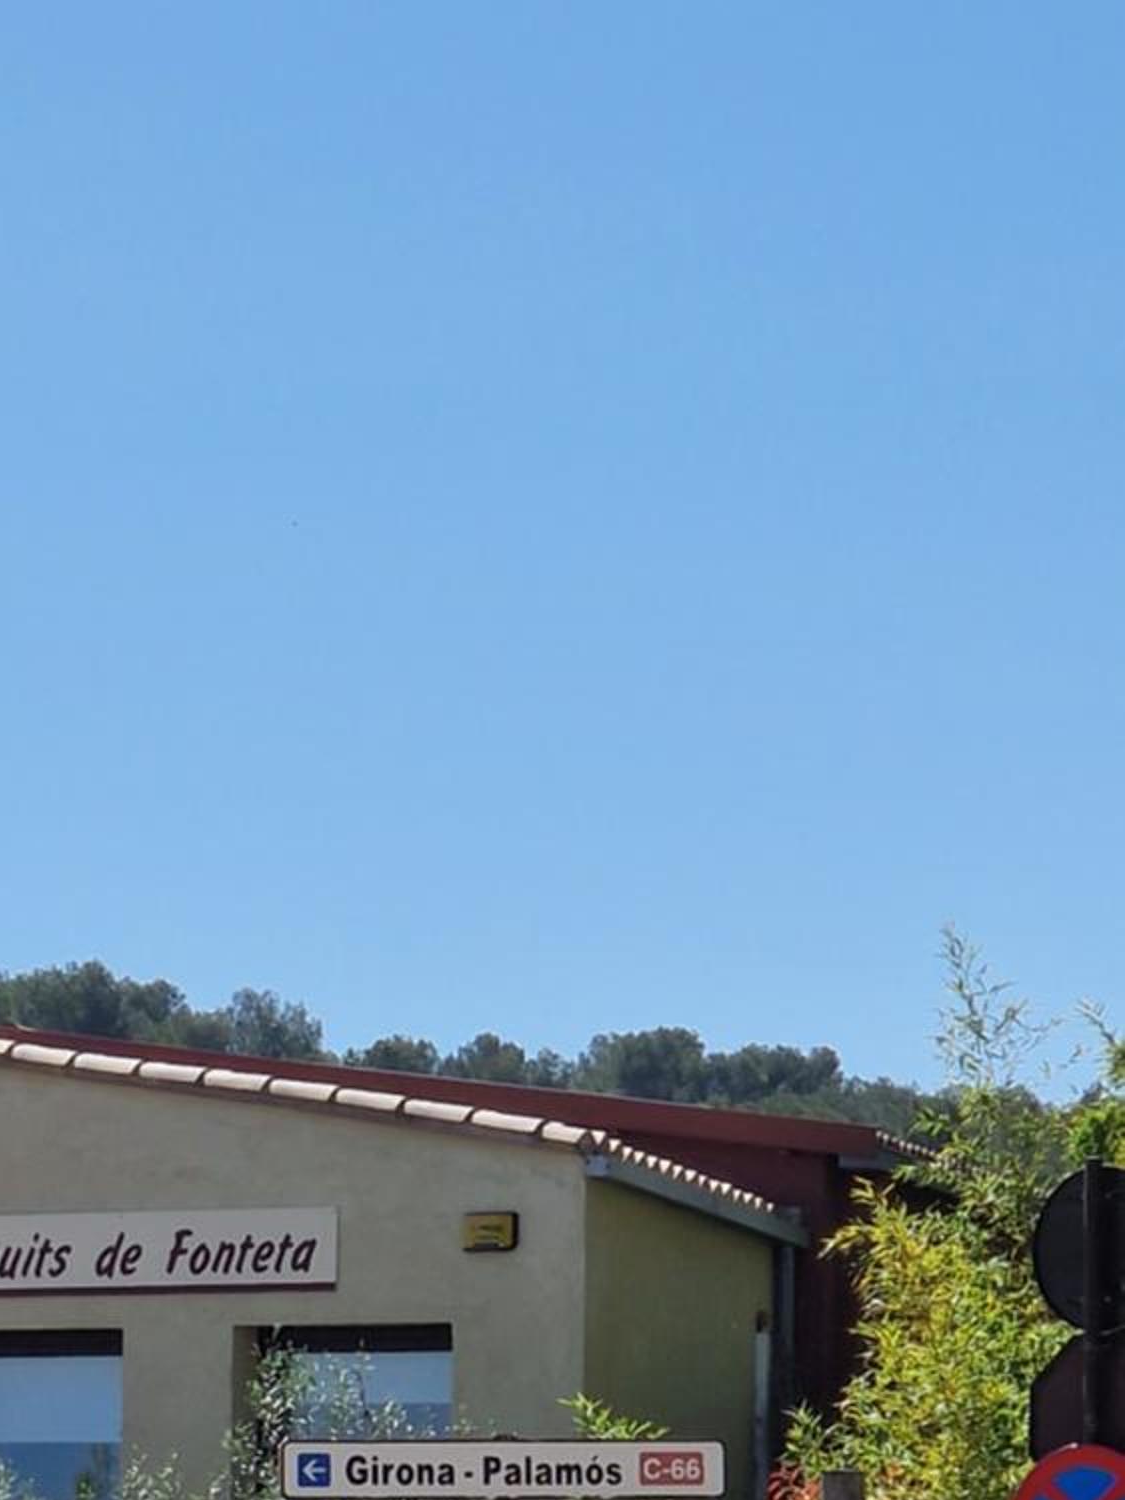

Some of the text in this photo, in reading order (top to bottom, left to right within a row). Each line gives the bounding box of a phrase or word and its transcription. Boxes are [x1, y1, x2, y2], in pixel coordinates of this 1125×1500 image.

[95, 1231, 143, 1279] de
[166, 1228, 318, 1276] Fonteta
[345, 1455, 455, 1486] Girona
[482, 1455, 623, 1486] Palamós
[642, 1457, 701, 1480] C-66
